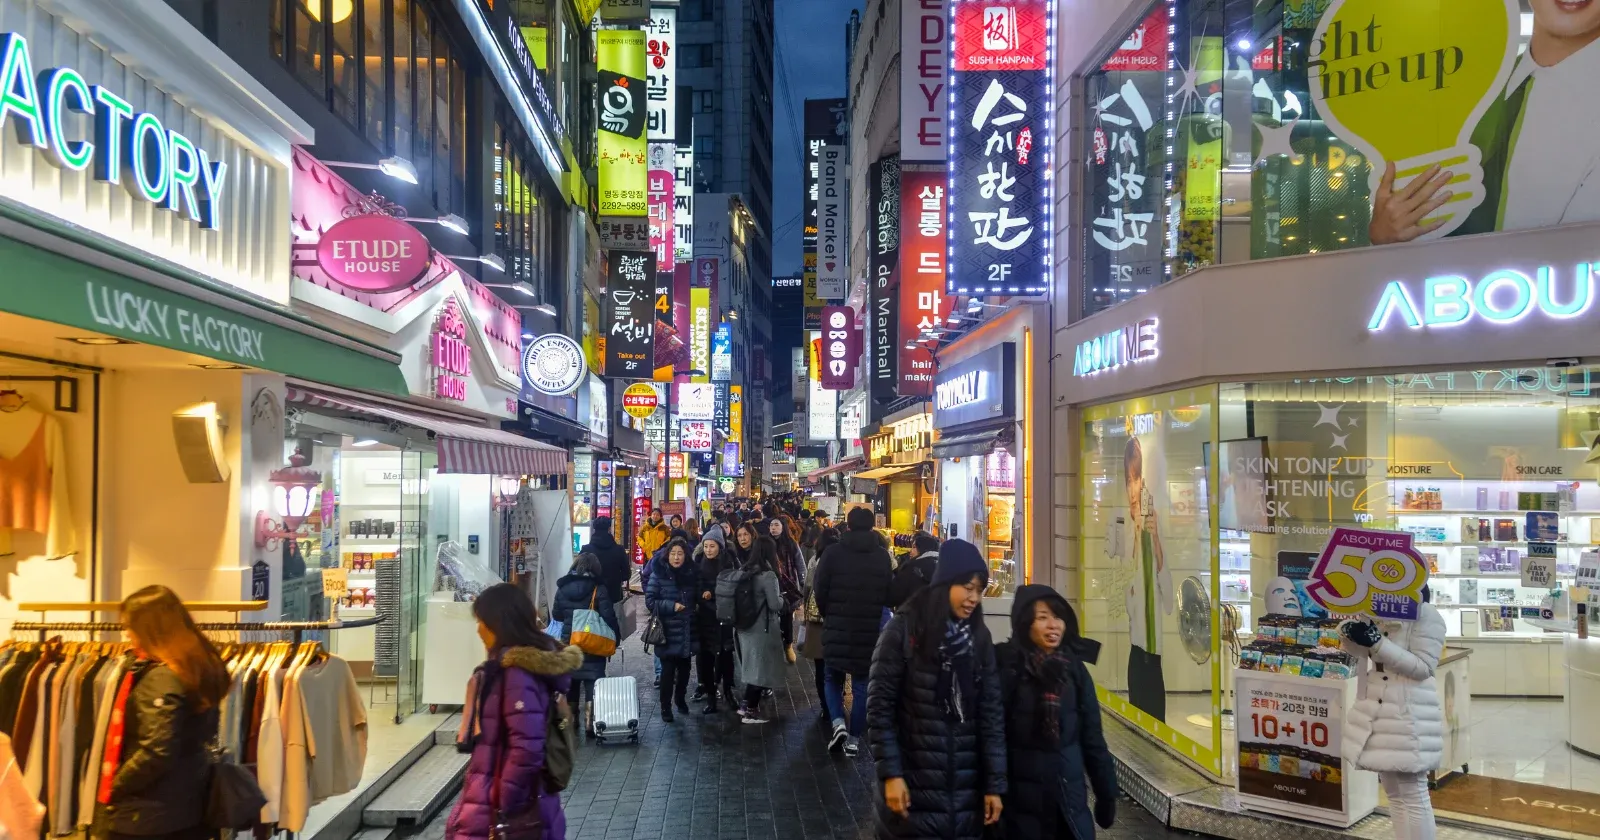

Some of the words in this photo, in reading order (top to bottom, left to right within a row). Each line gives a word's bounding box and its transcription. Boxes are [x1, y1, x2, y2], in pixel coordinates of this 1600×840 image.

[968, 56, 994, 65] SUSHI
[995, 55, 1035, 64] HANPAN
[1318, 61, 1391, 100] me
[1397, 45, 1464, 92] up
[825, 151, 838, 198] Brand
[602, 202, 646, 211] 2292-5892
[918, 186, 943, 237] 샬롱
[610, 224, 648, 241] 부동산
[825, 203, 838, 259] Market
[879, 201, 891, 255] Salon
[332, 240, 412, 260] ETUDE
[344, 261, 400, 273] HOUSE
[918, 252, 942, 273] 드
[879, 265, 891, 288] de
[988, 263, 1011, 281] 2F
[1367, 262, 1600, 331] ABOU
[86, 281, 172, 340] LUCKY
[176, 308, 264, 362] FACTORY
[879, 298, 891, 379] Marshall
[1073, 328, 1124, 376] ABOUT
[1124, 317, 1158, 362] ME
[438, 332, 472, 377] ETUDE
[625, 361, 637, 370] 2F
[912, 360, 932, 369] hair
[1236, 457, 1279, 475] SKIN
[1284, 457, 1340, 475] TONE
[1345, 457, 1374, 475] UP
[1387, 466, 1432, 474] MOISTURE
[1516, 466, 1537, 475] SKIN
[1538, 466, 1562, 475] CARE
[1245, 479, 1356, 498] IGHTENING
[1253, 500, 1292, 518] ASK
[1240, 525, 1290, 535] rightening
[1340, 535, 1384, 547] ABOUT
[1385, 539, 1403, 548] ME
[1532, 546, 1554, 554] VISA
[255, 581, 265, 598] 20
[1371, 592, 1410, 606] BRAND
[1371, 604, 1408, 615] SALE
[1251, 697, 1280, 711] 초특가
[1282, 703, 1306, 715] 20장
[1309, 706, 1328, 718] 만원
[1252, 713, 1329, 748] 10+10
[1274, 783, 1297, 795] ABOUT
[1296, 788, 1307, 796] ME
